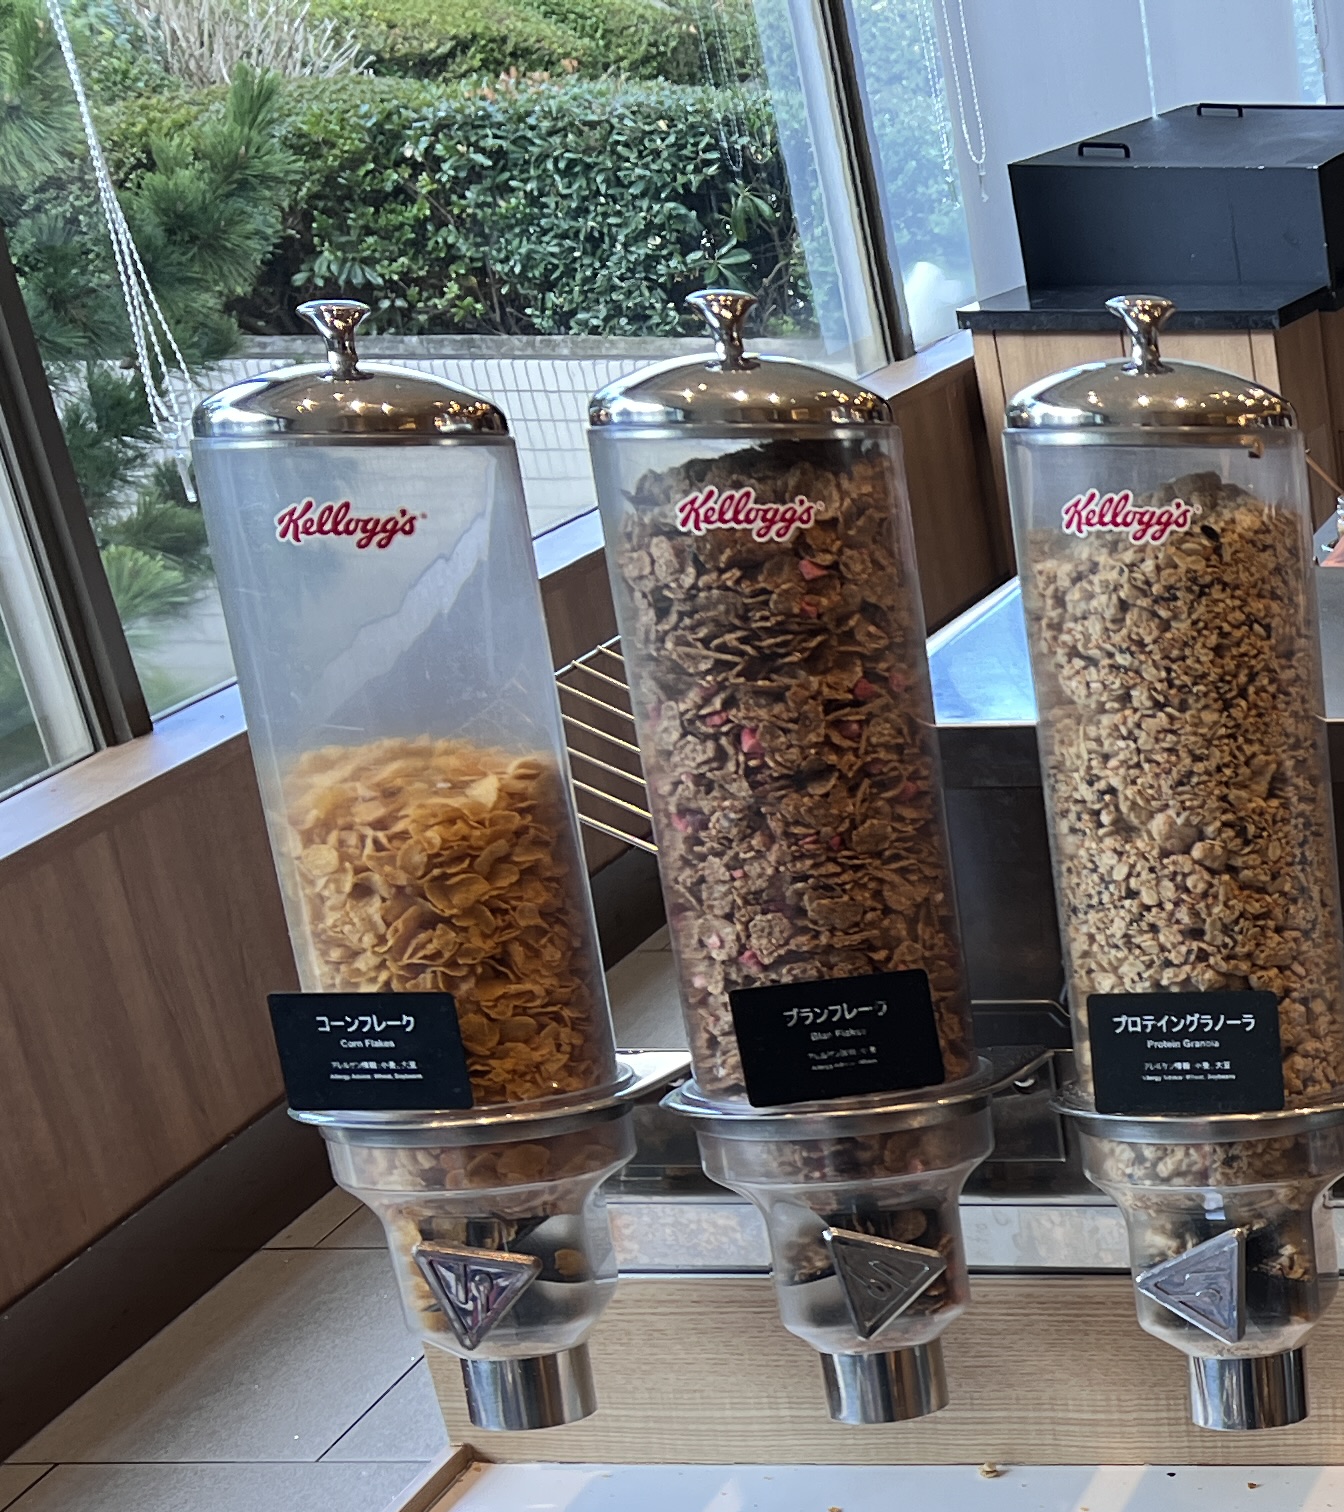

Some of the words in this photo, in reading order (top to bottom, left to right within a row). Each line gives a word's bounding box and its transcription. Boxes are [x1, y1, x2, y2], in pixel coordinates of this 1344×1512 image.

[276, 498, 418, 549] Kellogg's
[678, 488, 815, 539] Kellogg's
[1063, 490, 1191, 542] Kellogg's
[315, 1013, 416, 1033] コーンフレーク
[783, 1001, 888, 1028] ブランフレーク
[1112, 1013, 1256, 1034] プロテイングラノーラ
[339, 1038, 363, 1049] Corn
[364, 1038, 396, 1049] Flakes
[1146, 1039, 1181, 1049] Protein
[1182, 1038, 1220, 1049] Granola
